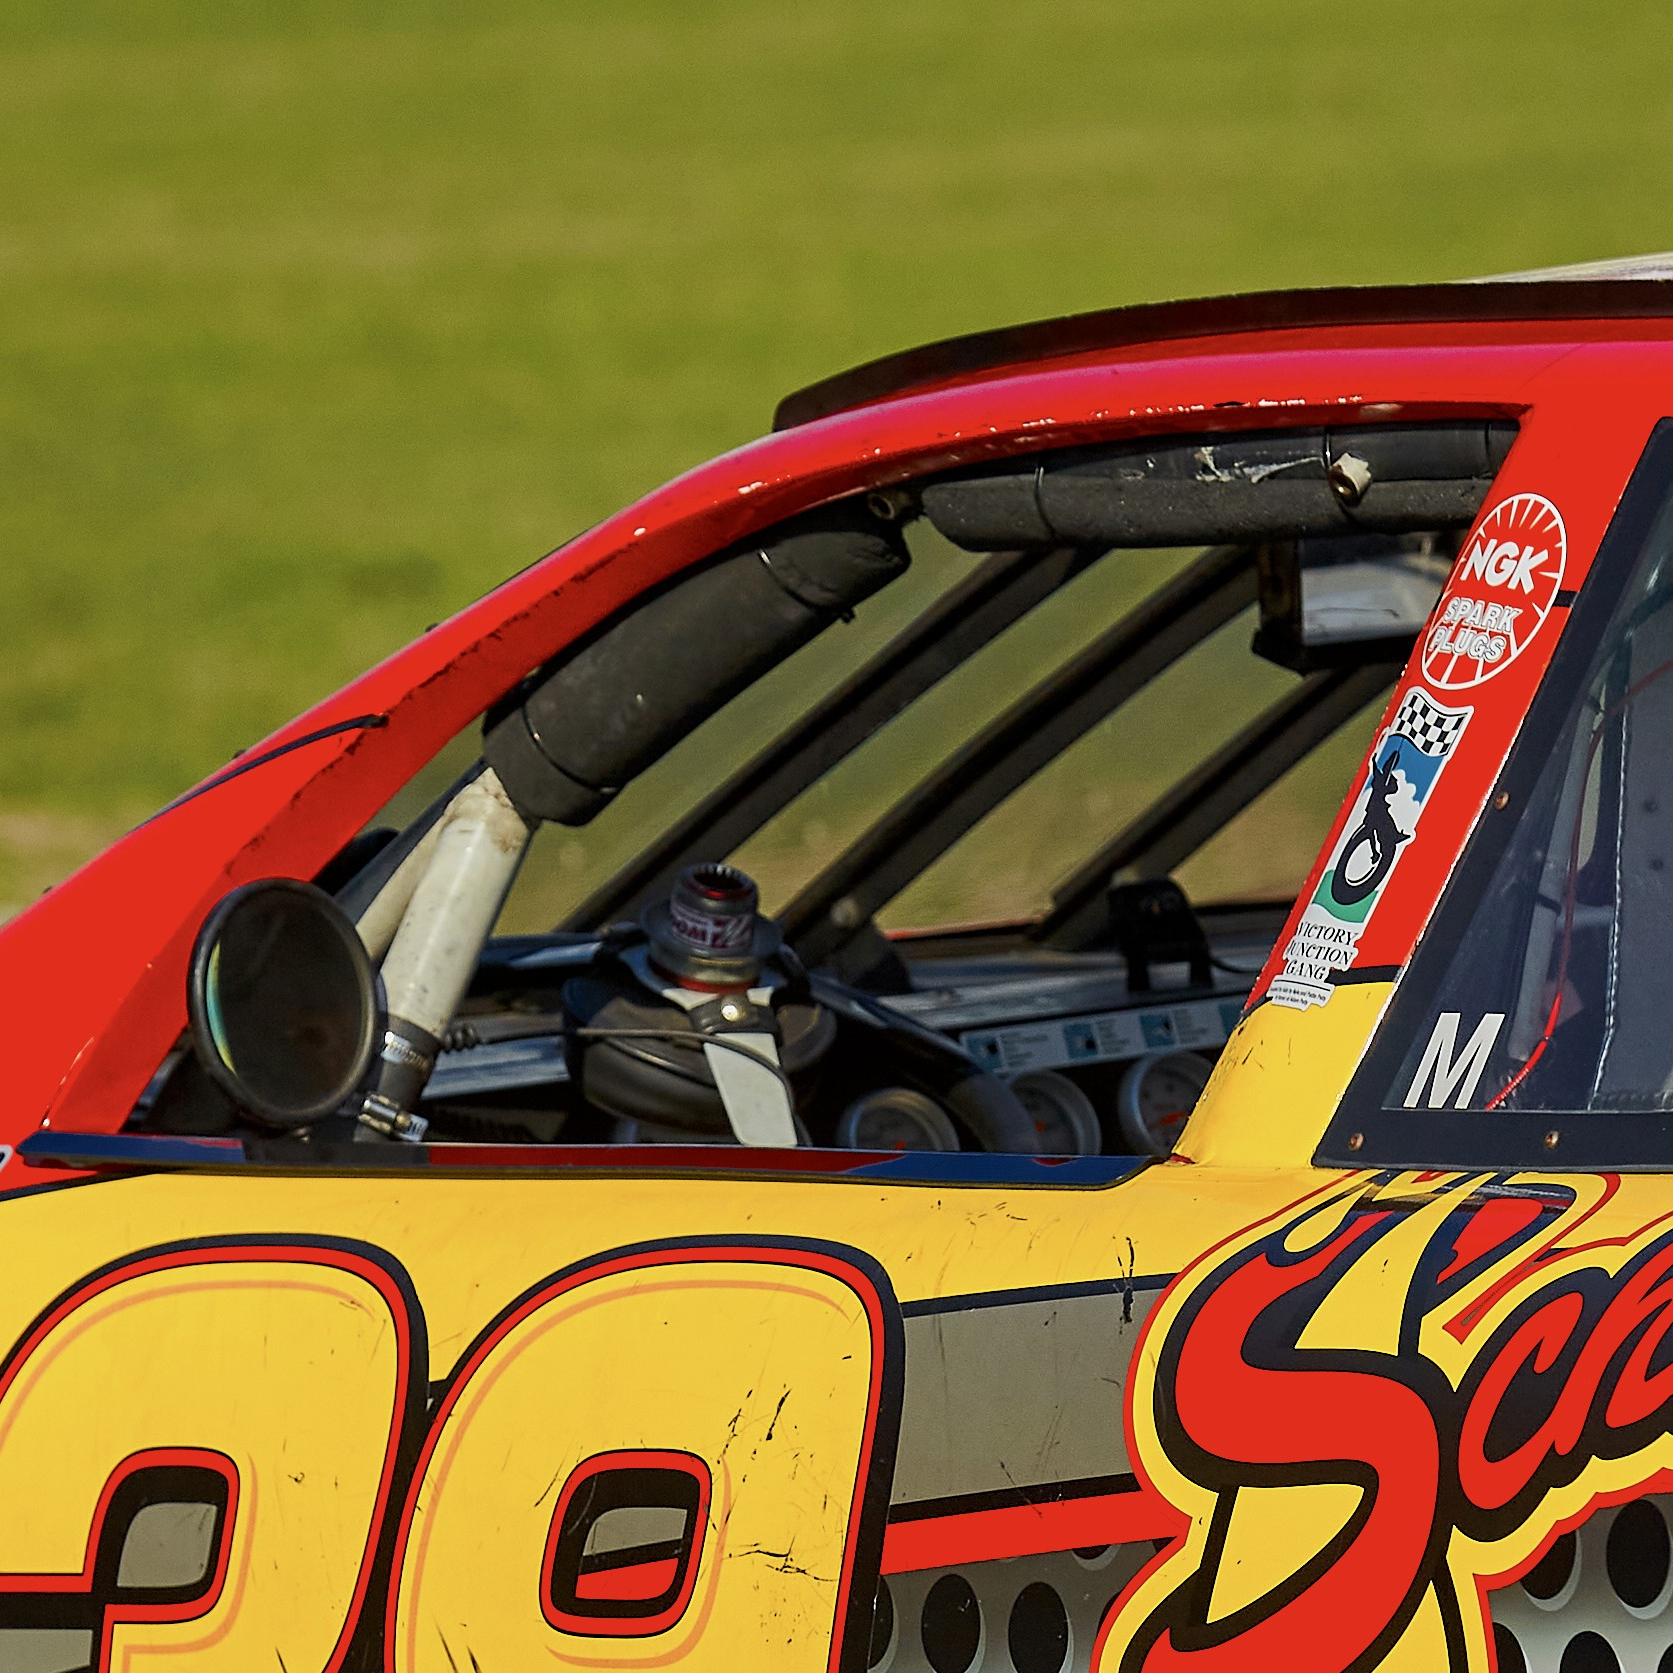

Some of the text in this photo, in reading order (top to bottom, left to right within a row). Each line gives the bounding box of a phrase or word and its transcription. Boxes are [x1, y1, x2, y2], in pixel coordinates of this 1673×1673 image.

[1459, 537, 1549, 595] NGK
[1443, 596, 1524, 634] SPARK
[1427, 625, 1507, 664] PLUGS
[1285, 939, 1354, 966] JUNCTION
[1297, 921, 1360, 946] VICTORY
[1286, 960, 1327, 981] GANG
[1403, 1012, 1506, 1110] M
